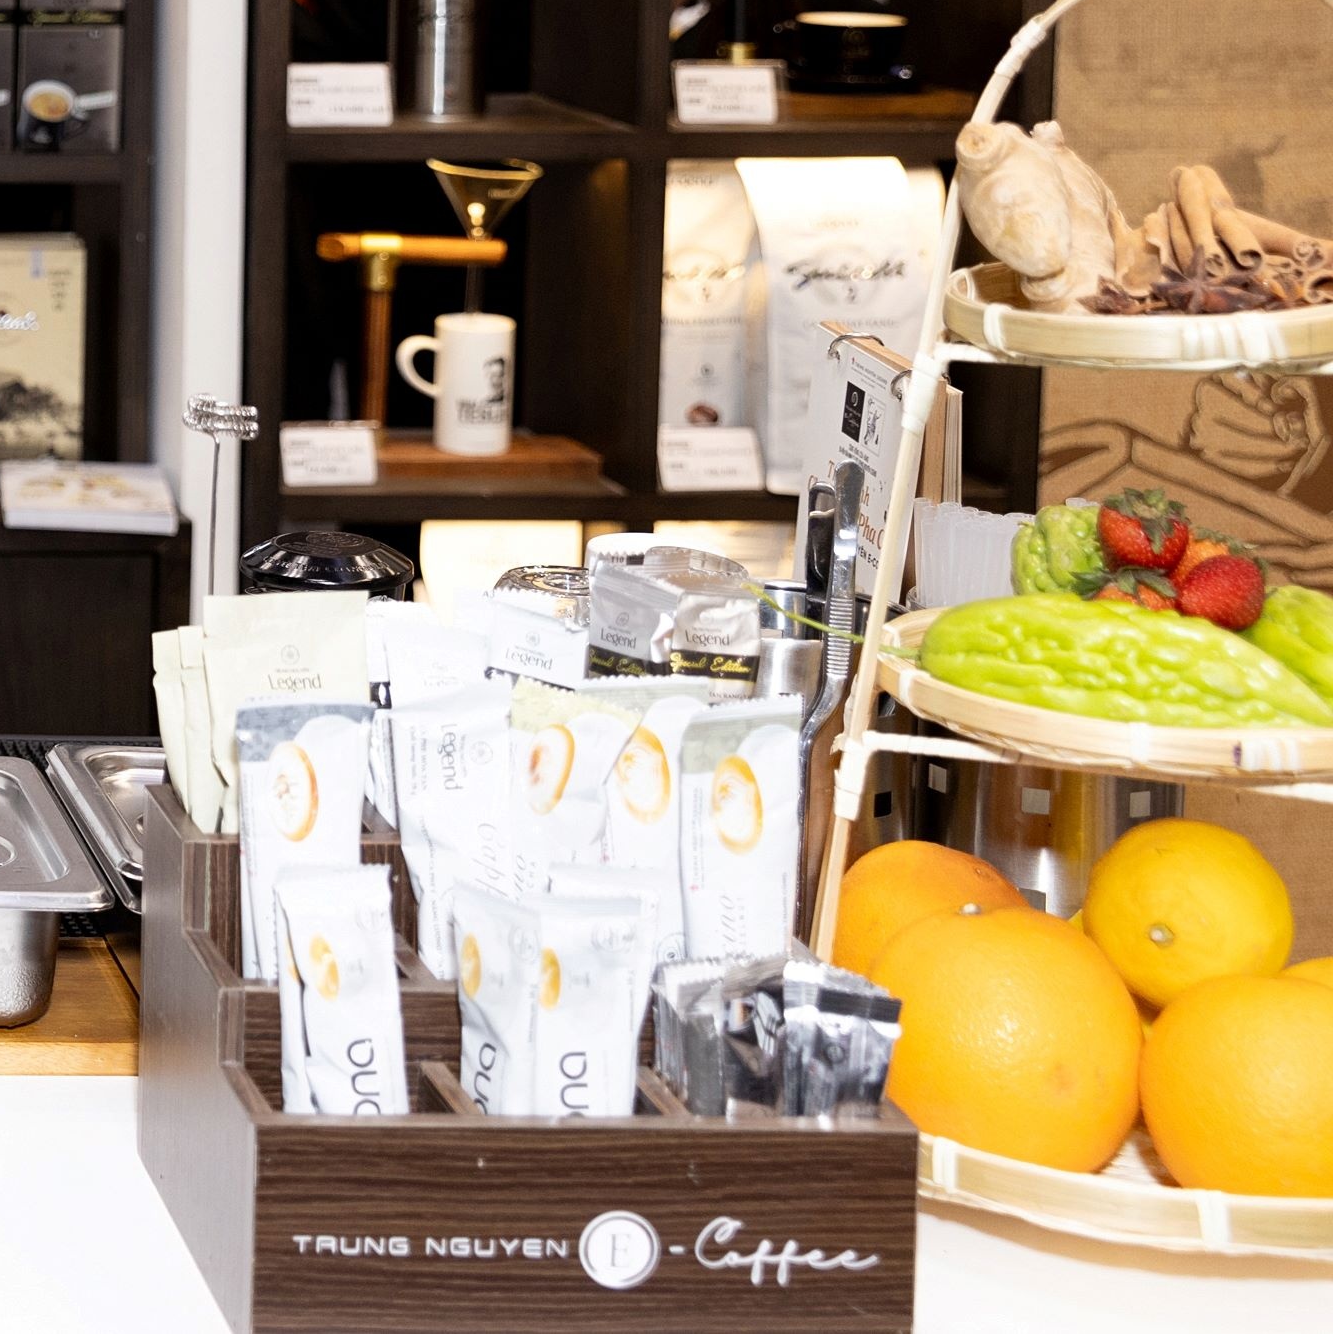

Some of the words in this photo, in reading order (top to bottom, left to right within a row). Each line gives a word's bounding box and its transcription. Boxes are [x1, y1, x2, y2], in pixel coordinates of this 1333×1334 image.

[600, 627, 637, 649] Legend
[685, 629, 731, 647] Legend
[670, 652, 707, 673] Special
[709, 657, 752, 674] Edition
[267, 674, 323, 693] Legend
[437, 723, 464, 791] Legend
[346, 1038, 381, 1115] ona
[293, 1234, 410, 1256] TRUNG
[425, 1235, 568, 1259] NGUYEN
